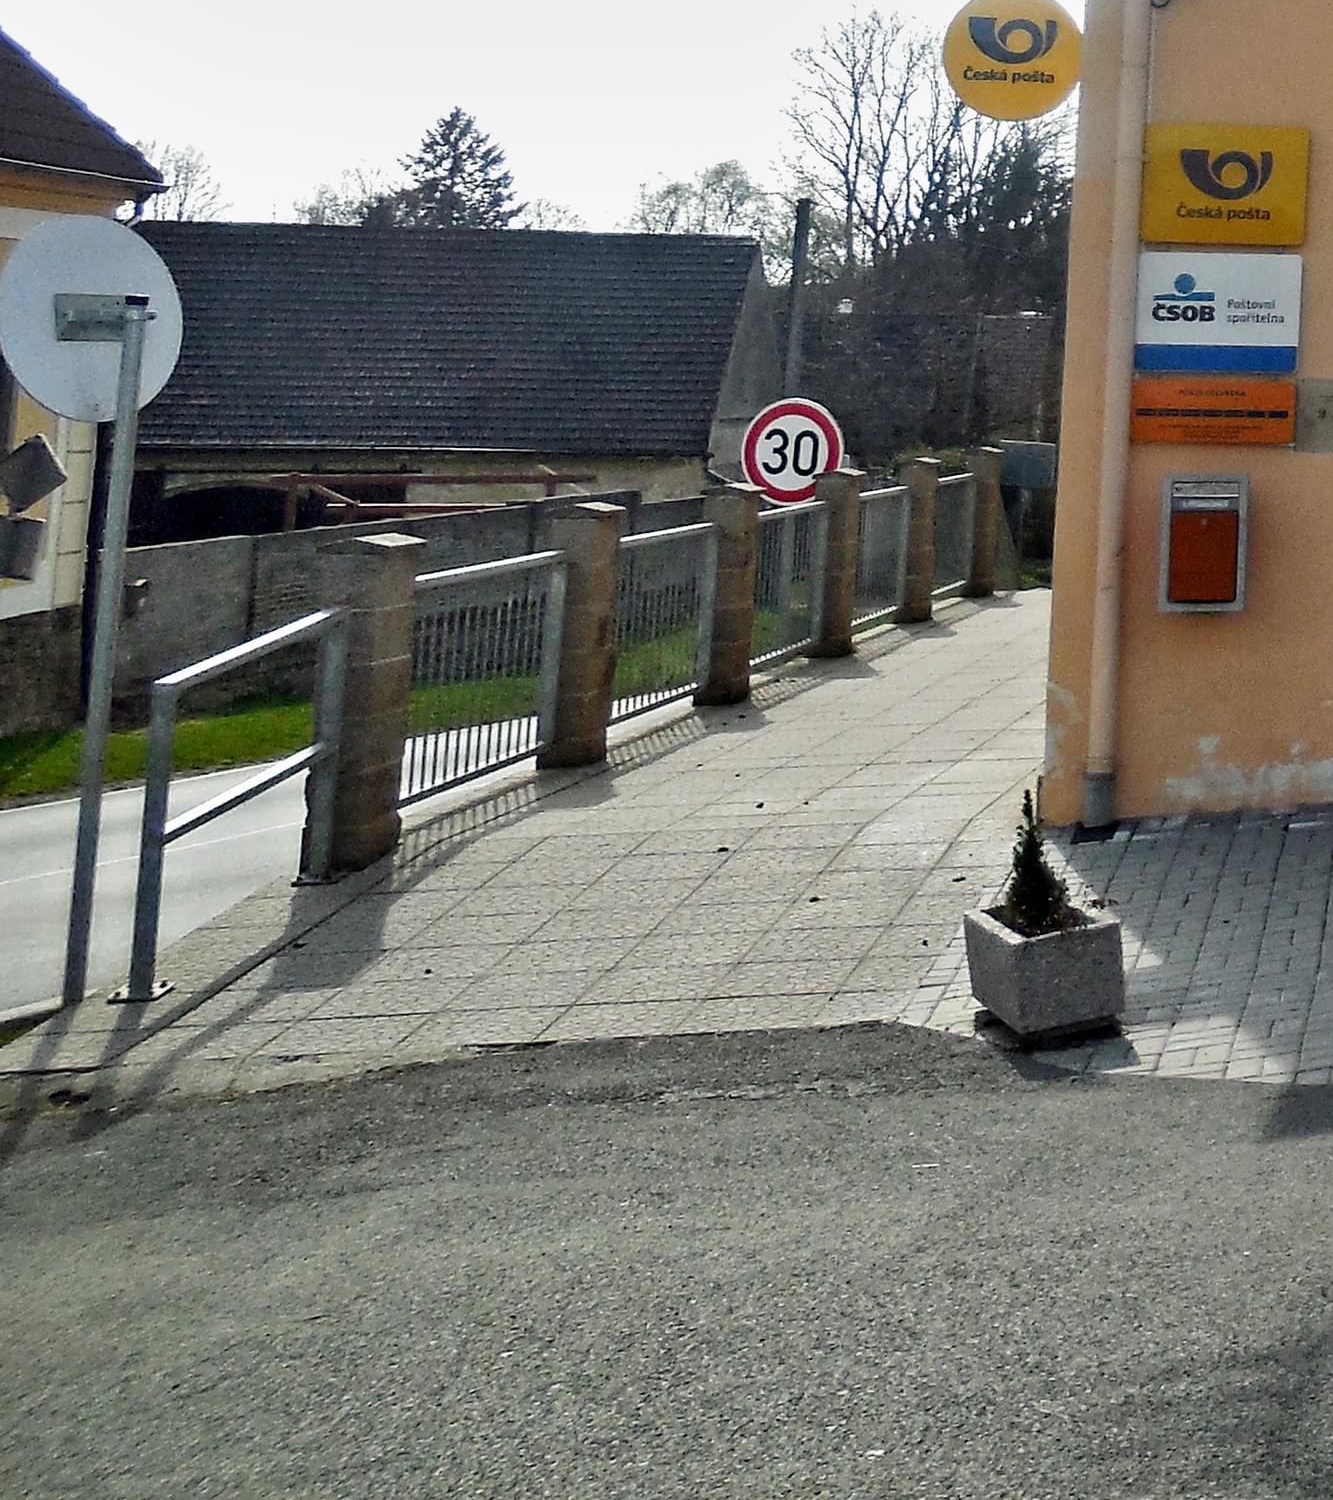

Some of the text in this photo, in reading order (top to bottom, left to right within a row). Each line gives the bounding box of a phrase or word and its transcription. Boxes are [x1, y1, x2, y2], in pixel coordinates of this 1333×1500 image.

[963, 65, 1055, 84] Česká pošta
[1176, 202, 1271, 221] Česká pošta
[1152, 302, 1216, 322] ČSOB
[762, 428, 819, 477] 30
